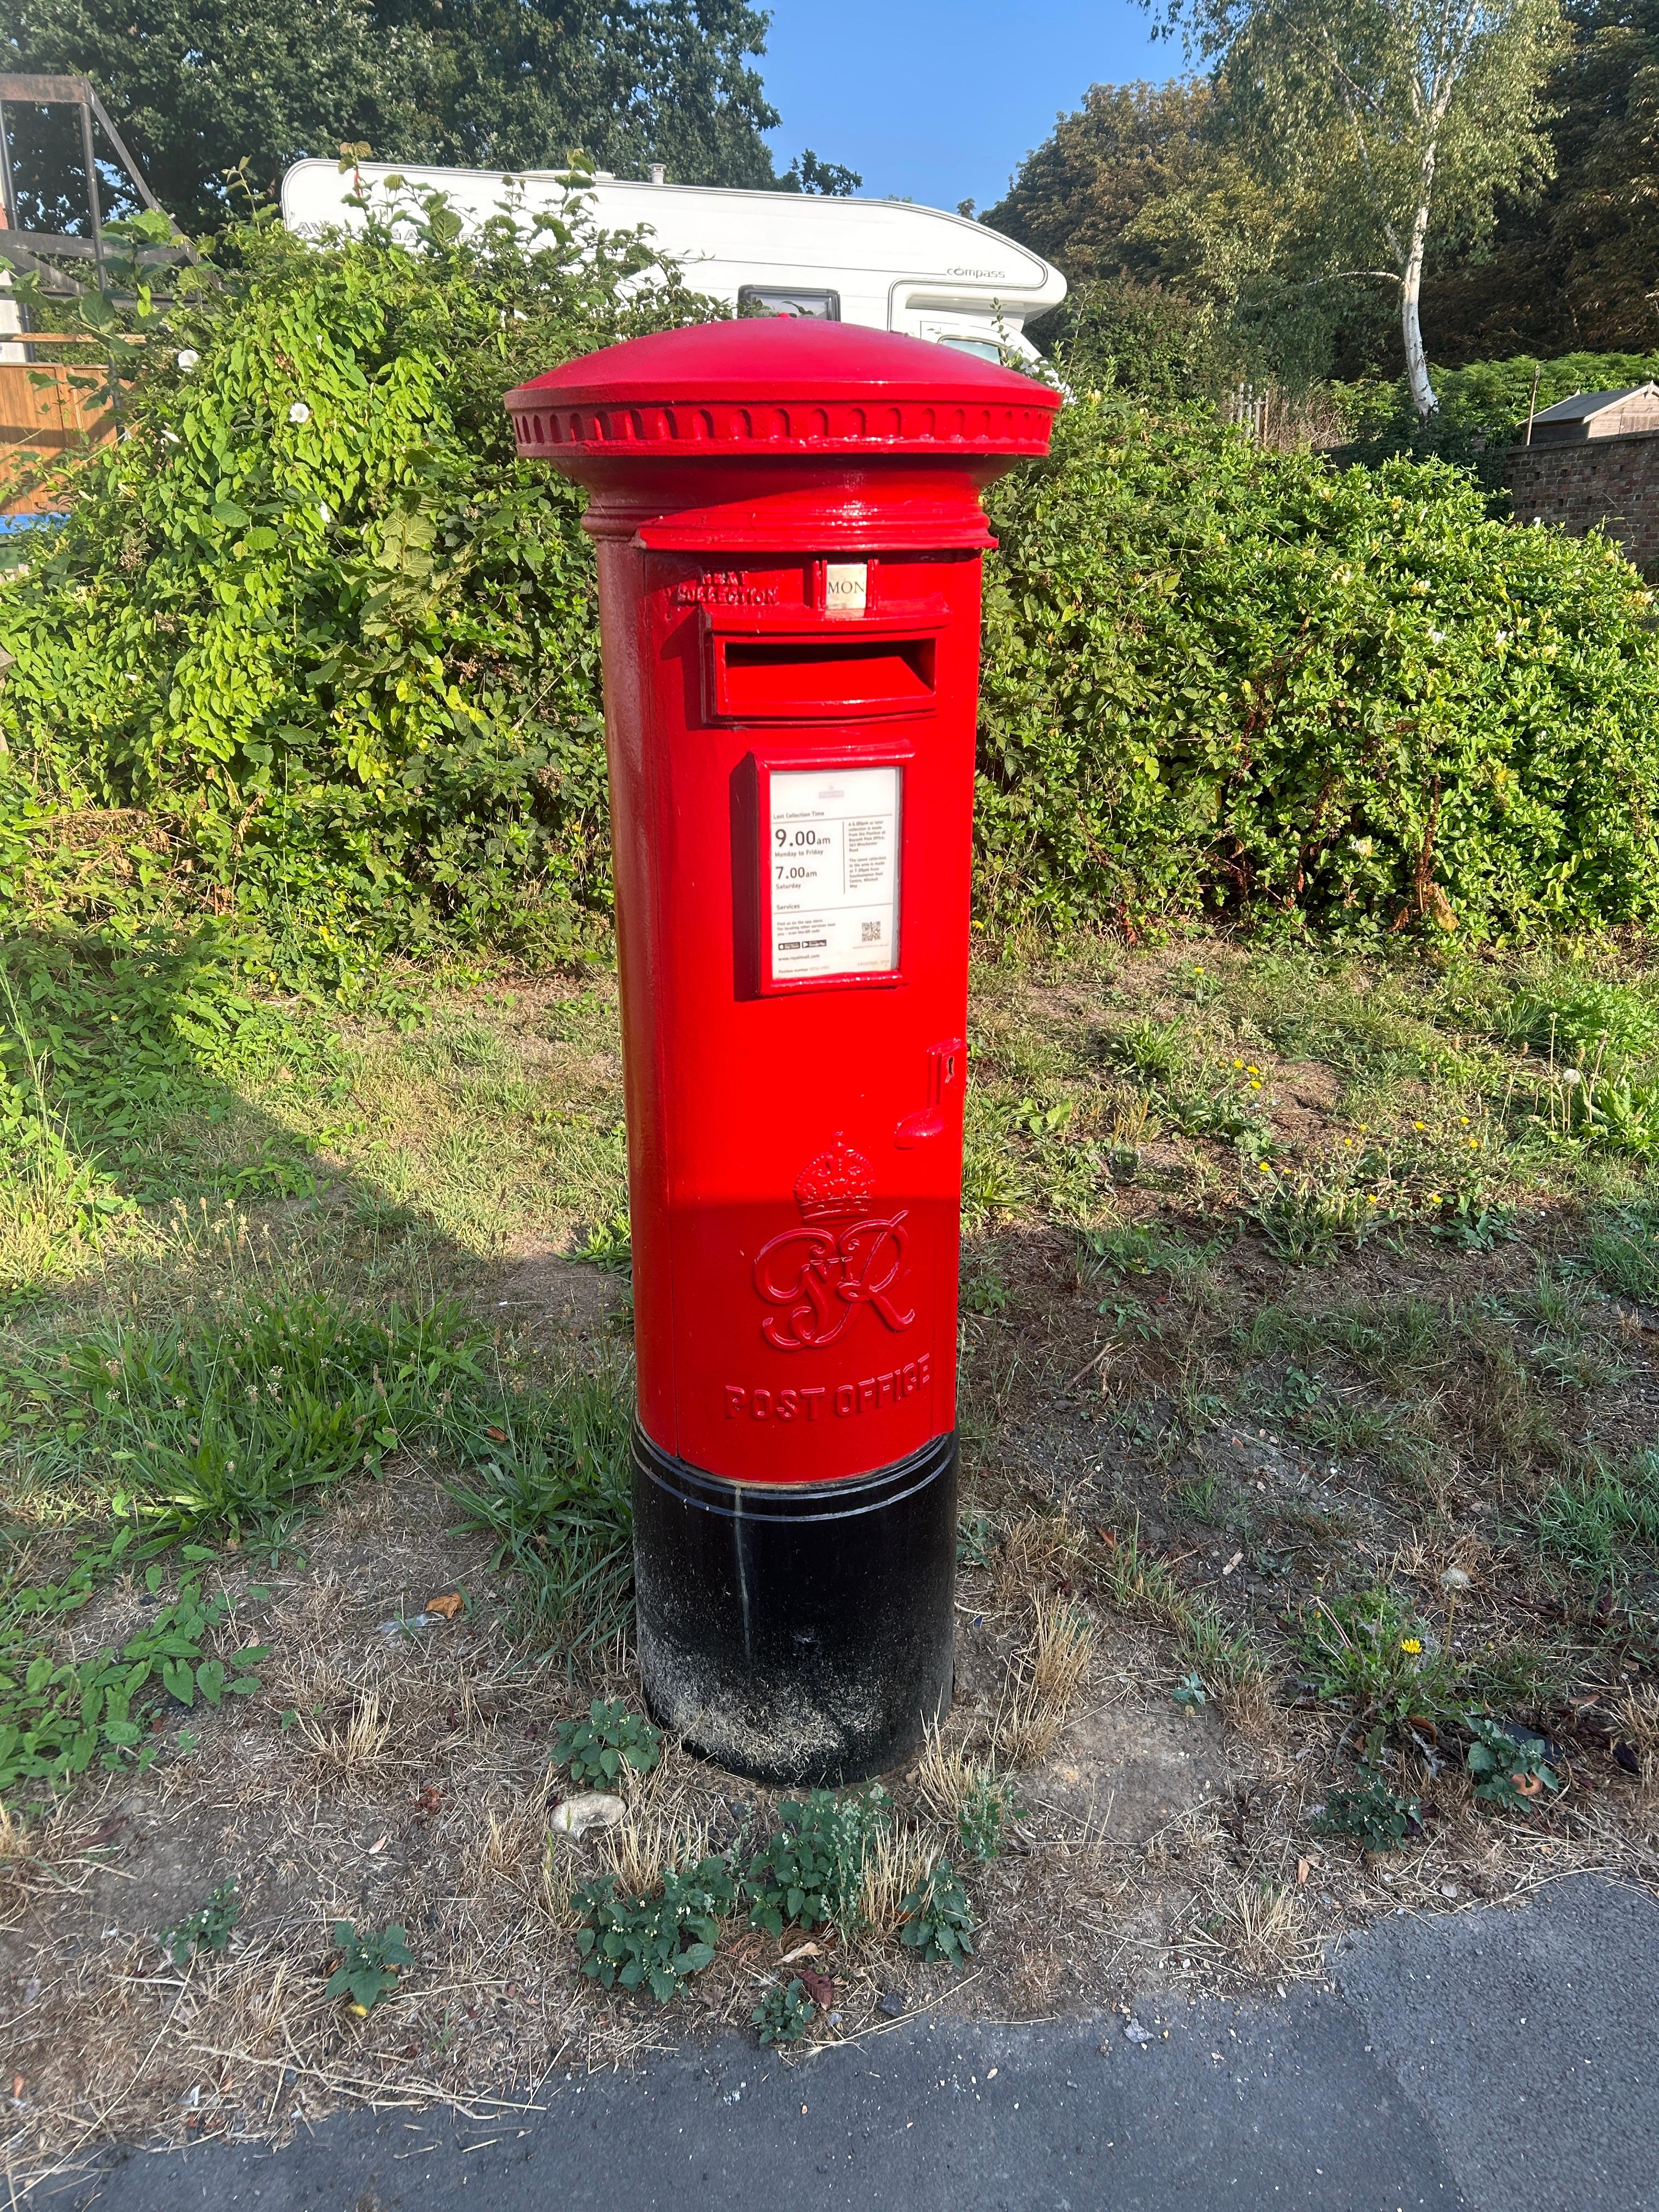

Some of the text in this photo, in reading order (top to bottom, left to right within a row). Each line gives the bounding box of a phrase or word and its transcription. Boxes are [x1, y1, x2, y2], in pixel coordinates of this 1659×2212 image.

[947, 267, 1005, 278] compass
[828, 581, 865, 594] MON
[775, 829, 831, 848] 9.00am
[775, 866, 817, 879] 7.00am
[725, 1353, 930, 1421] POST OFFICE
